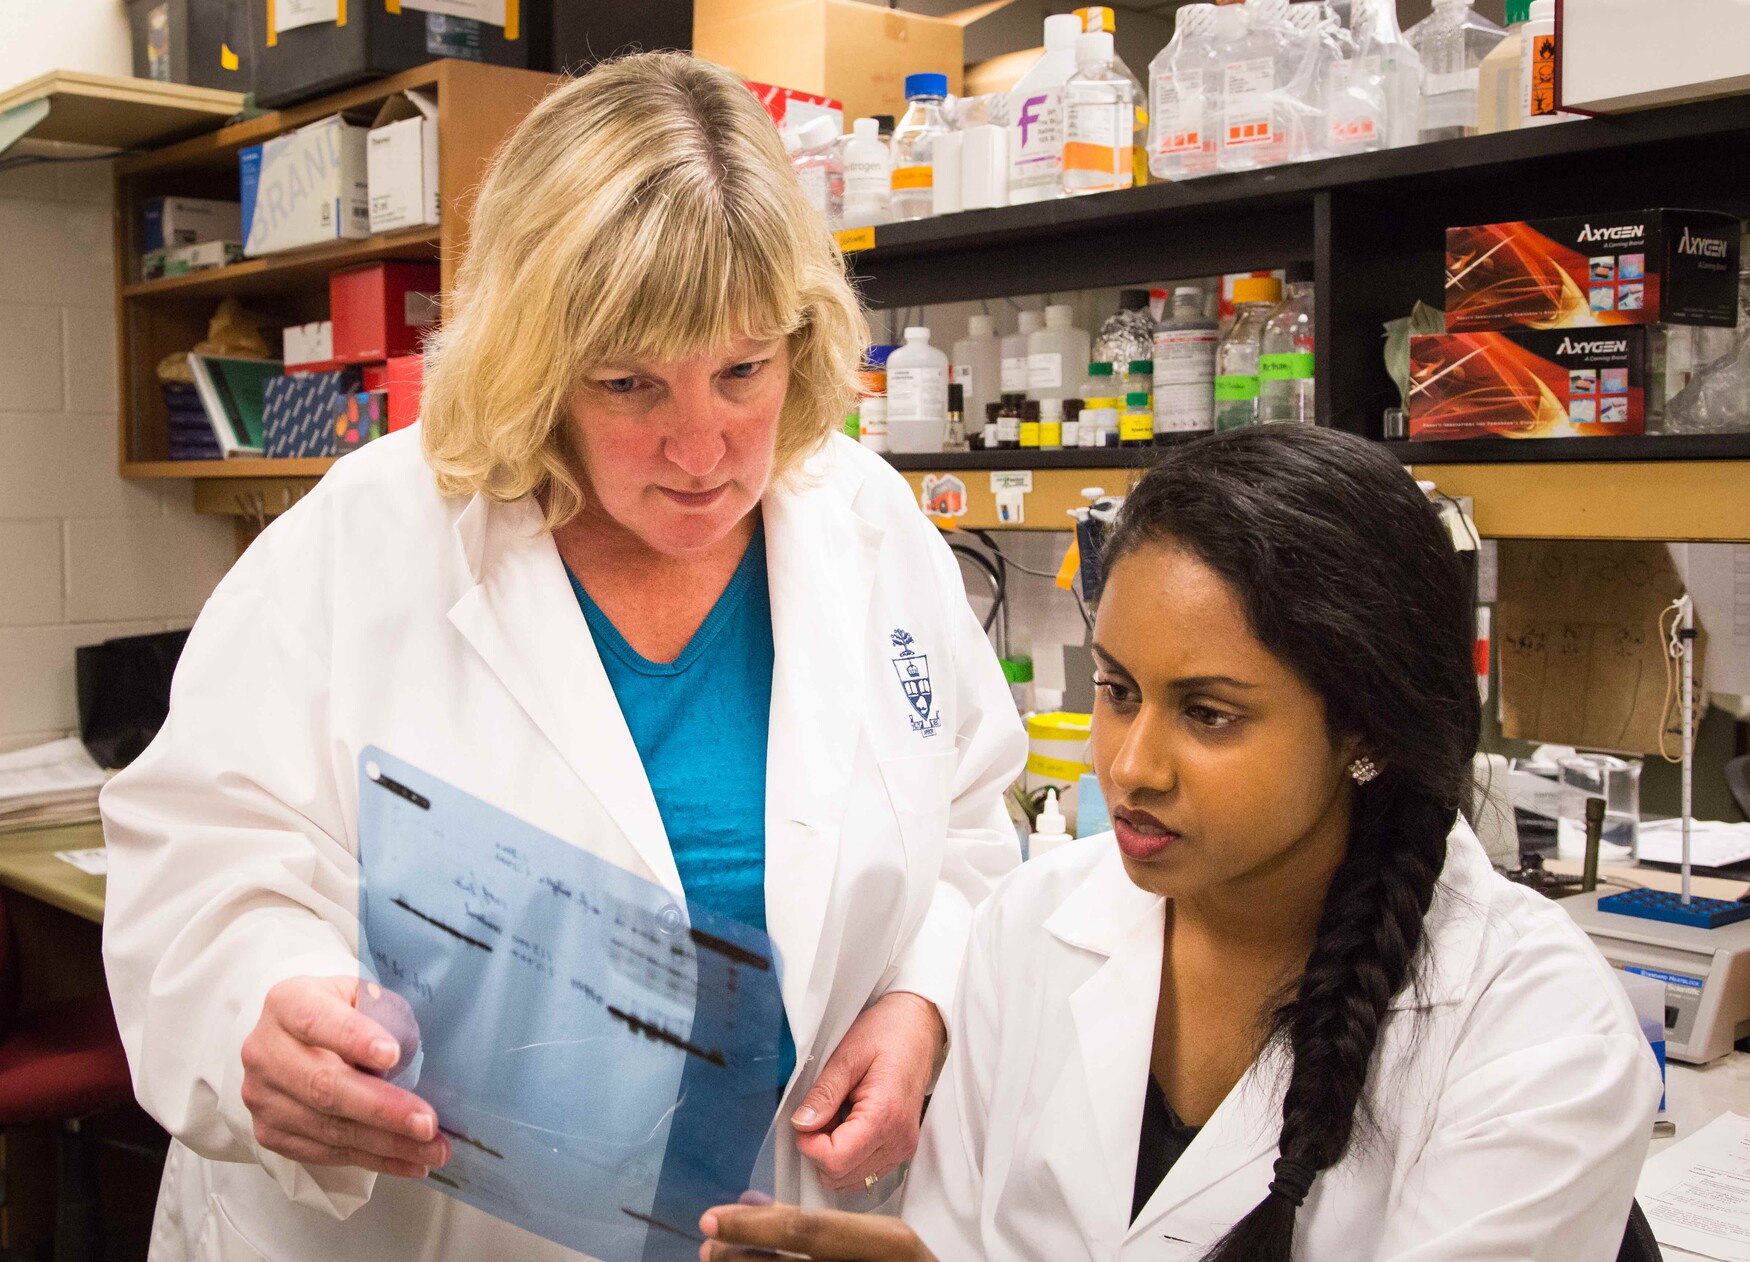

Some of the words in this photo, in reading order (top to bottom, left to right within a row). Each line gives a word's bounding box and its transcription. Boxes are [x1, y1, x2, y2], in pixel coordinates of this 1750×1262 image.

[1577, 223, 1645, 242] AXYGEN
[1678, 226, 1727, 258] AXYGEN
[1556, 336, 1627, 355] AXYGEN
